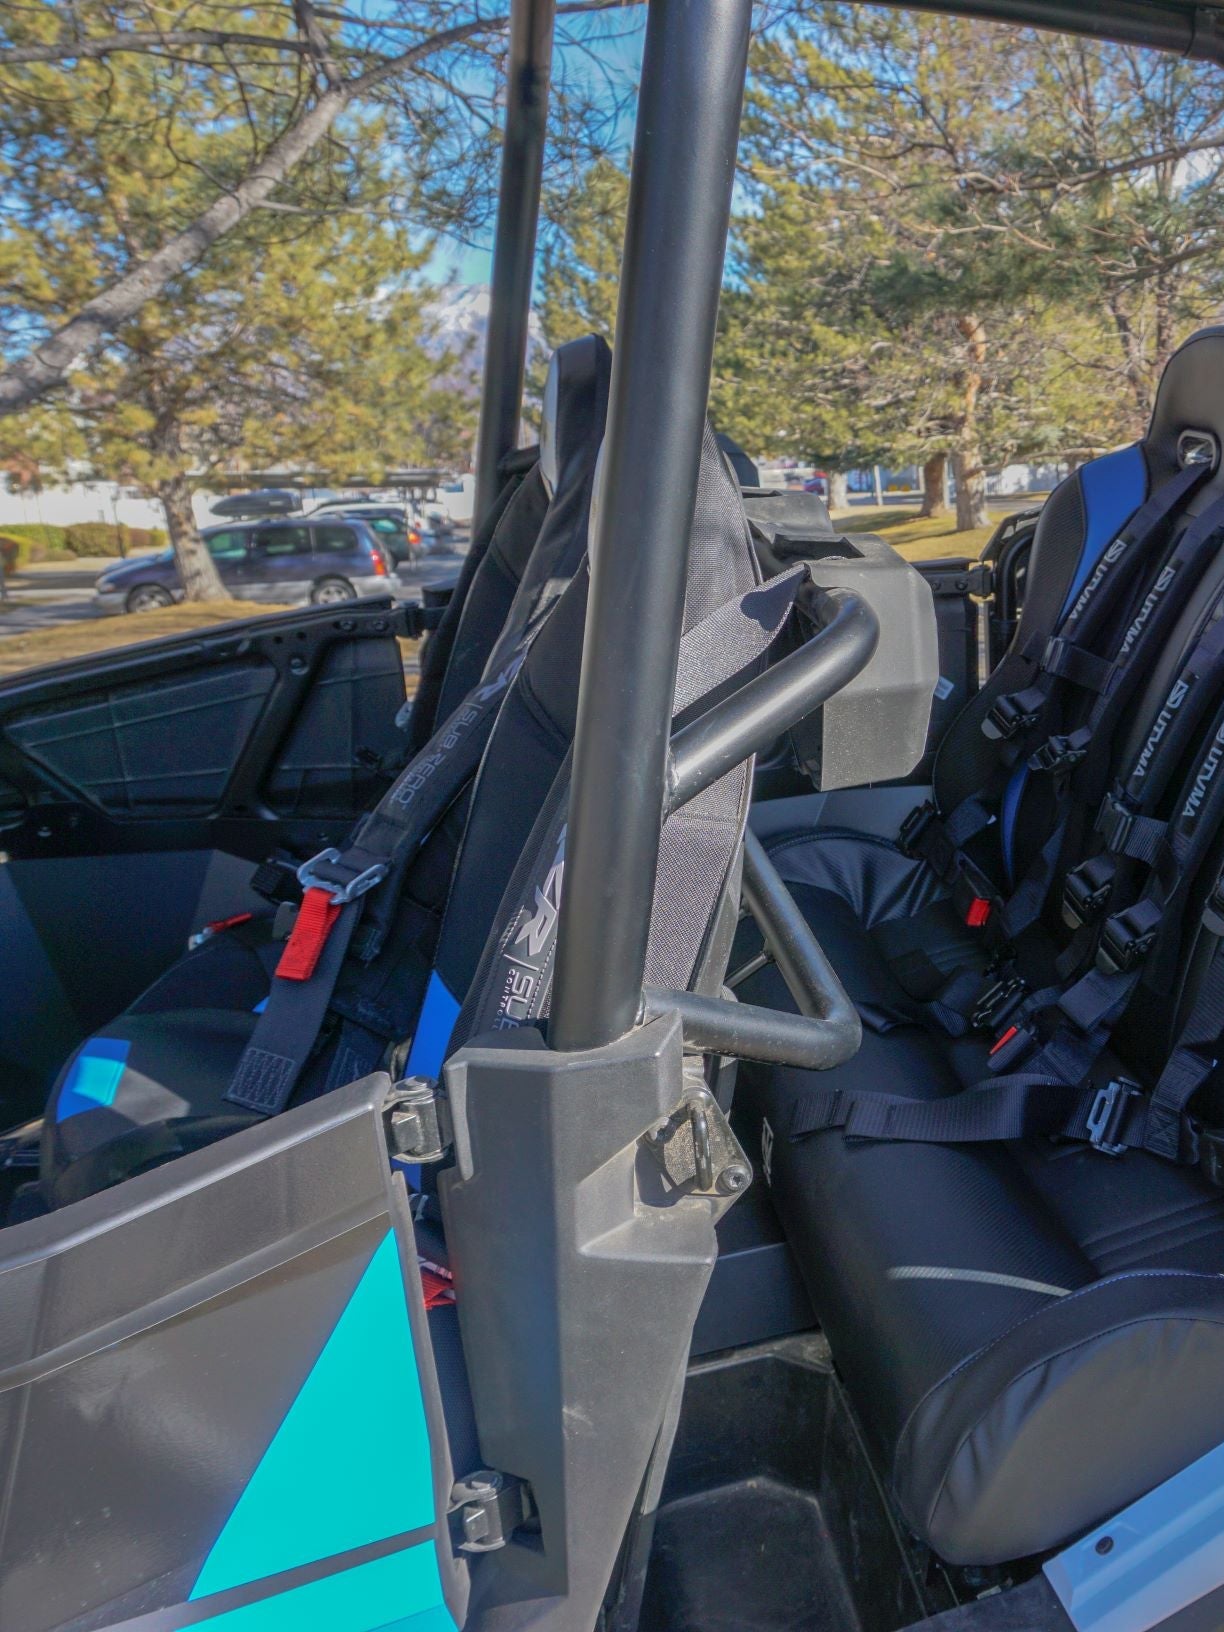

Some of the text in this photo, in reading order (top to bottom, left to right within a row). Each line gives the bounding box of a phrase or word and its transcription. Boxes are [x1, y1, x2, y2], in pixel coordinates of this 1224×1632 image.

[1069, 564, 1108, 619] UTVMA
[1120, 593, 1158, 652] UTVMA
[1132, 710, 1172, 777] UTVMA
[1182, 747, 1223, 817] UTVMA
